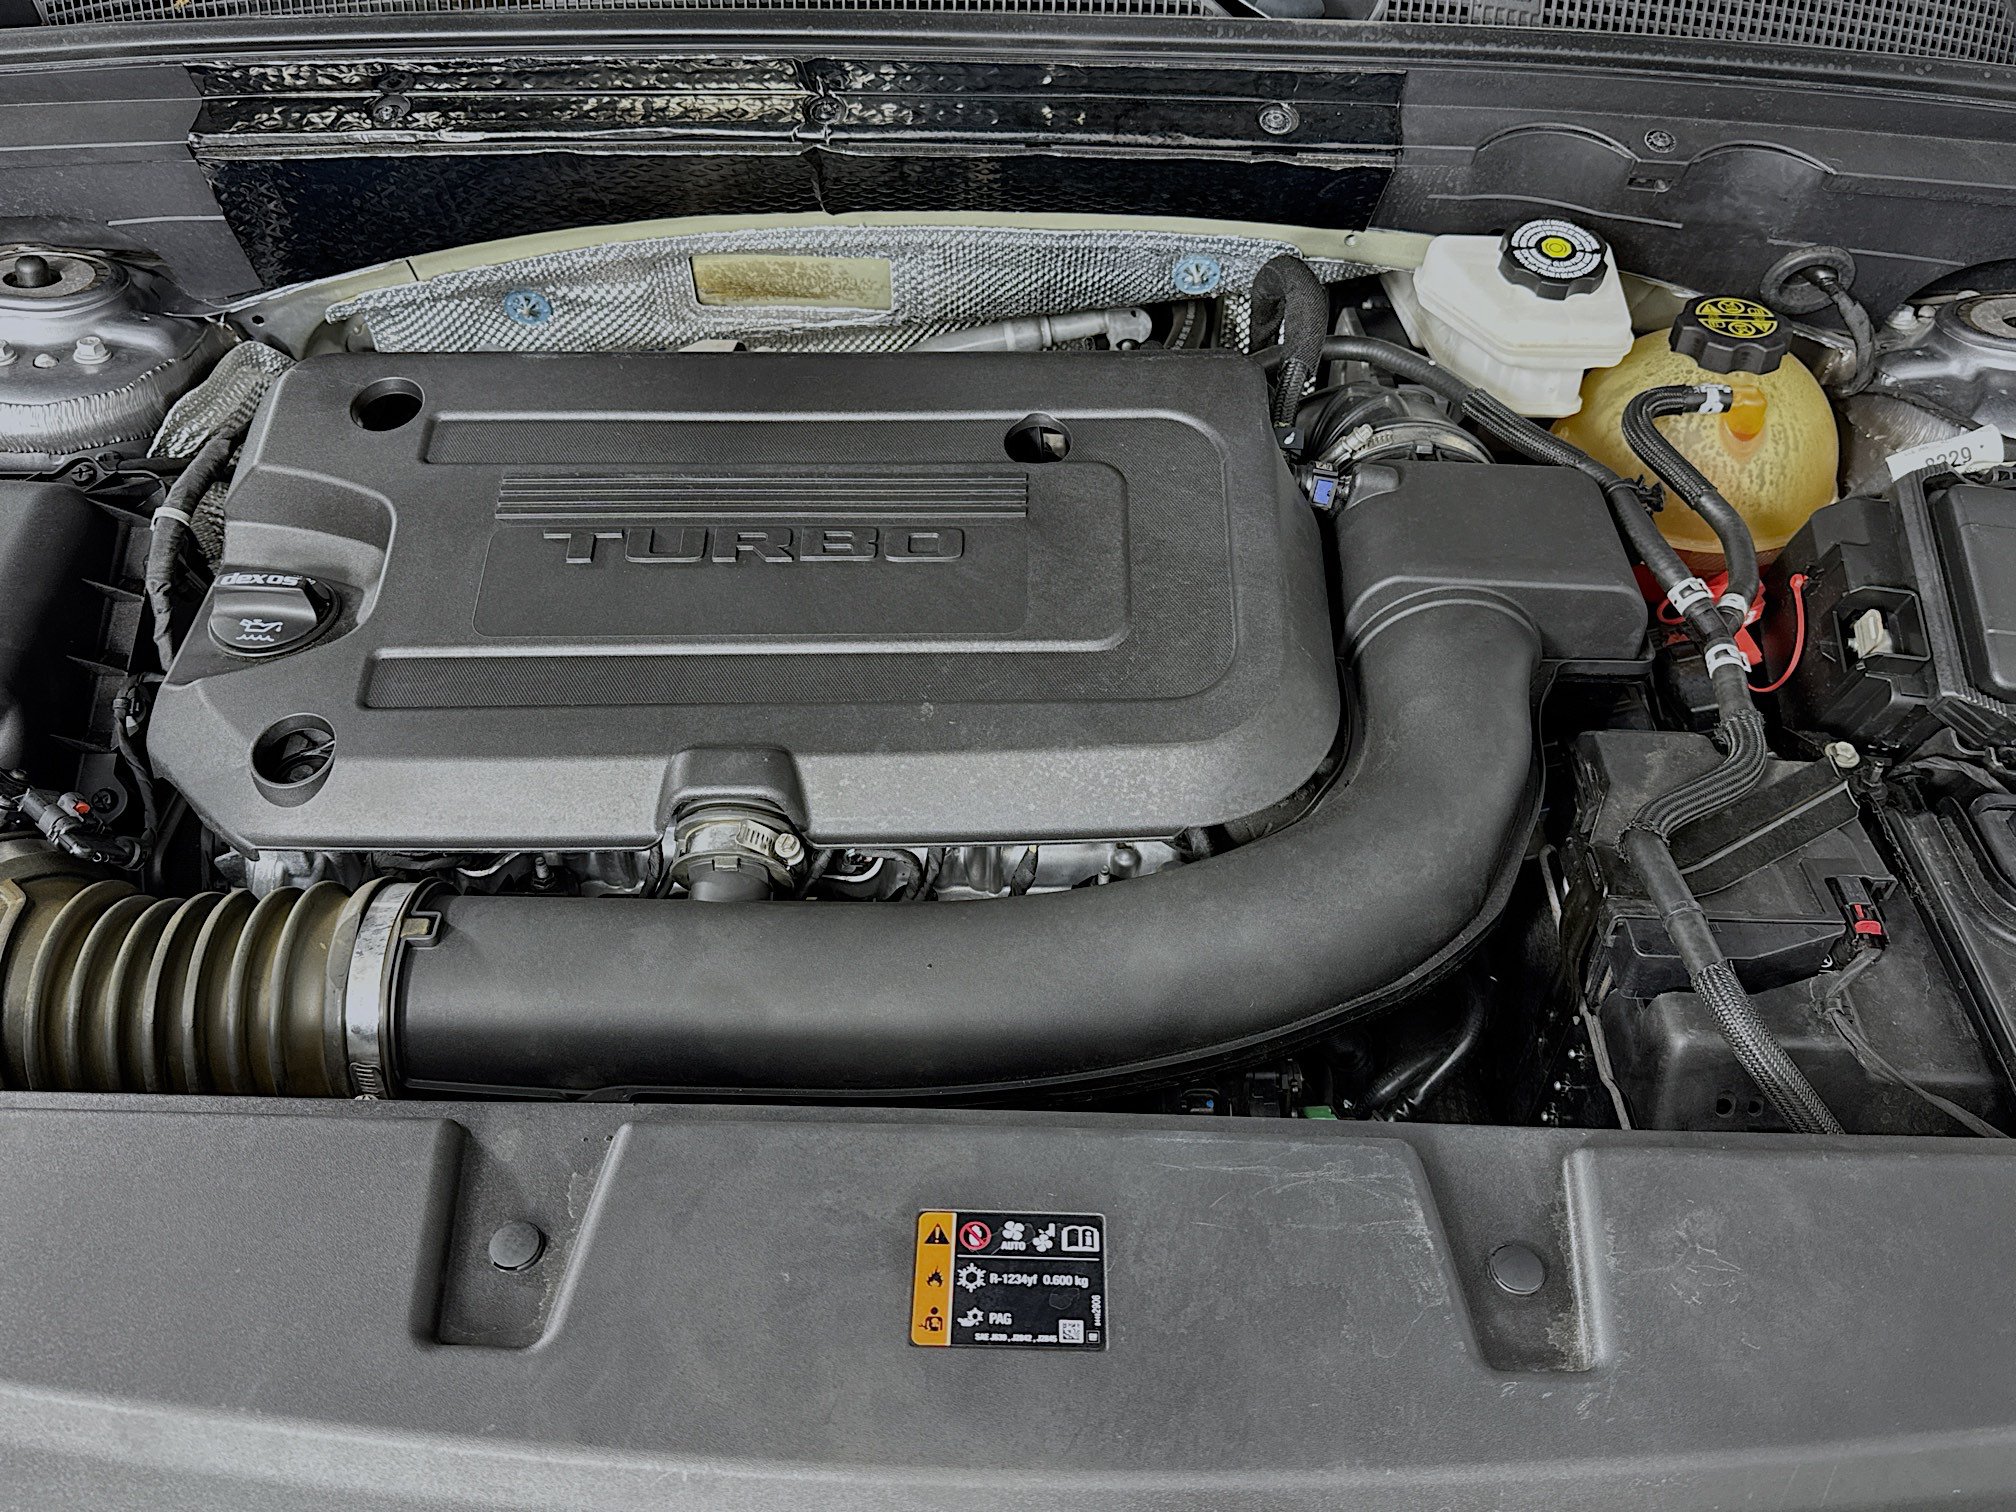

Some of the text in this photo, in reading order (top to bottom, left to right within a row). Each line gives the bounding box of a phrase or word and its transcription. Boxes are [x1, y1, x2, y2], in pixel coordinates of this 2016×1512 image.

[543, 527, 965, 563] TURBO
[221, 572, 302, 586] dexos
[1000, 1240, 1026, 1251] AUTO
[989, 1273, 1089, 1288] R-1234yf 0.600 kg
[988, 1312, 1012, 1325] PAG
